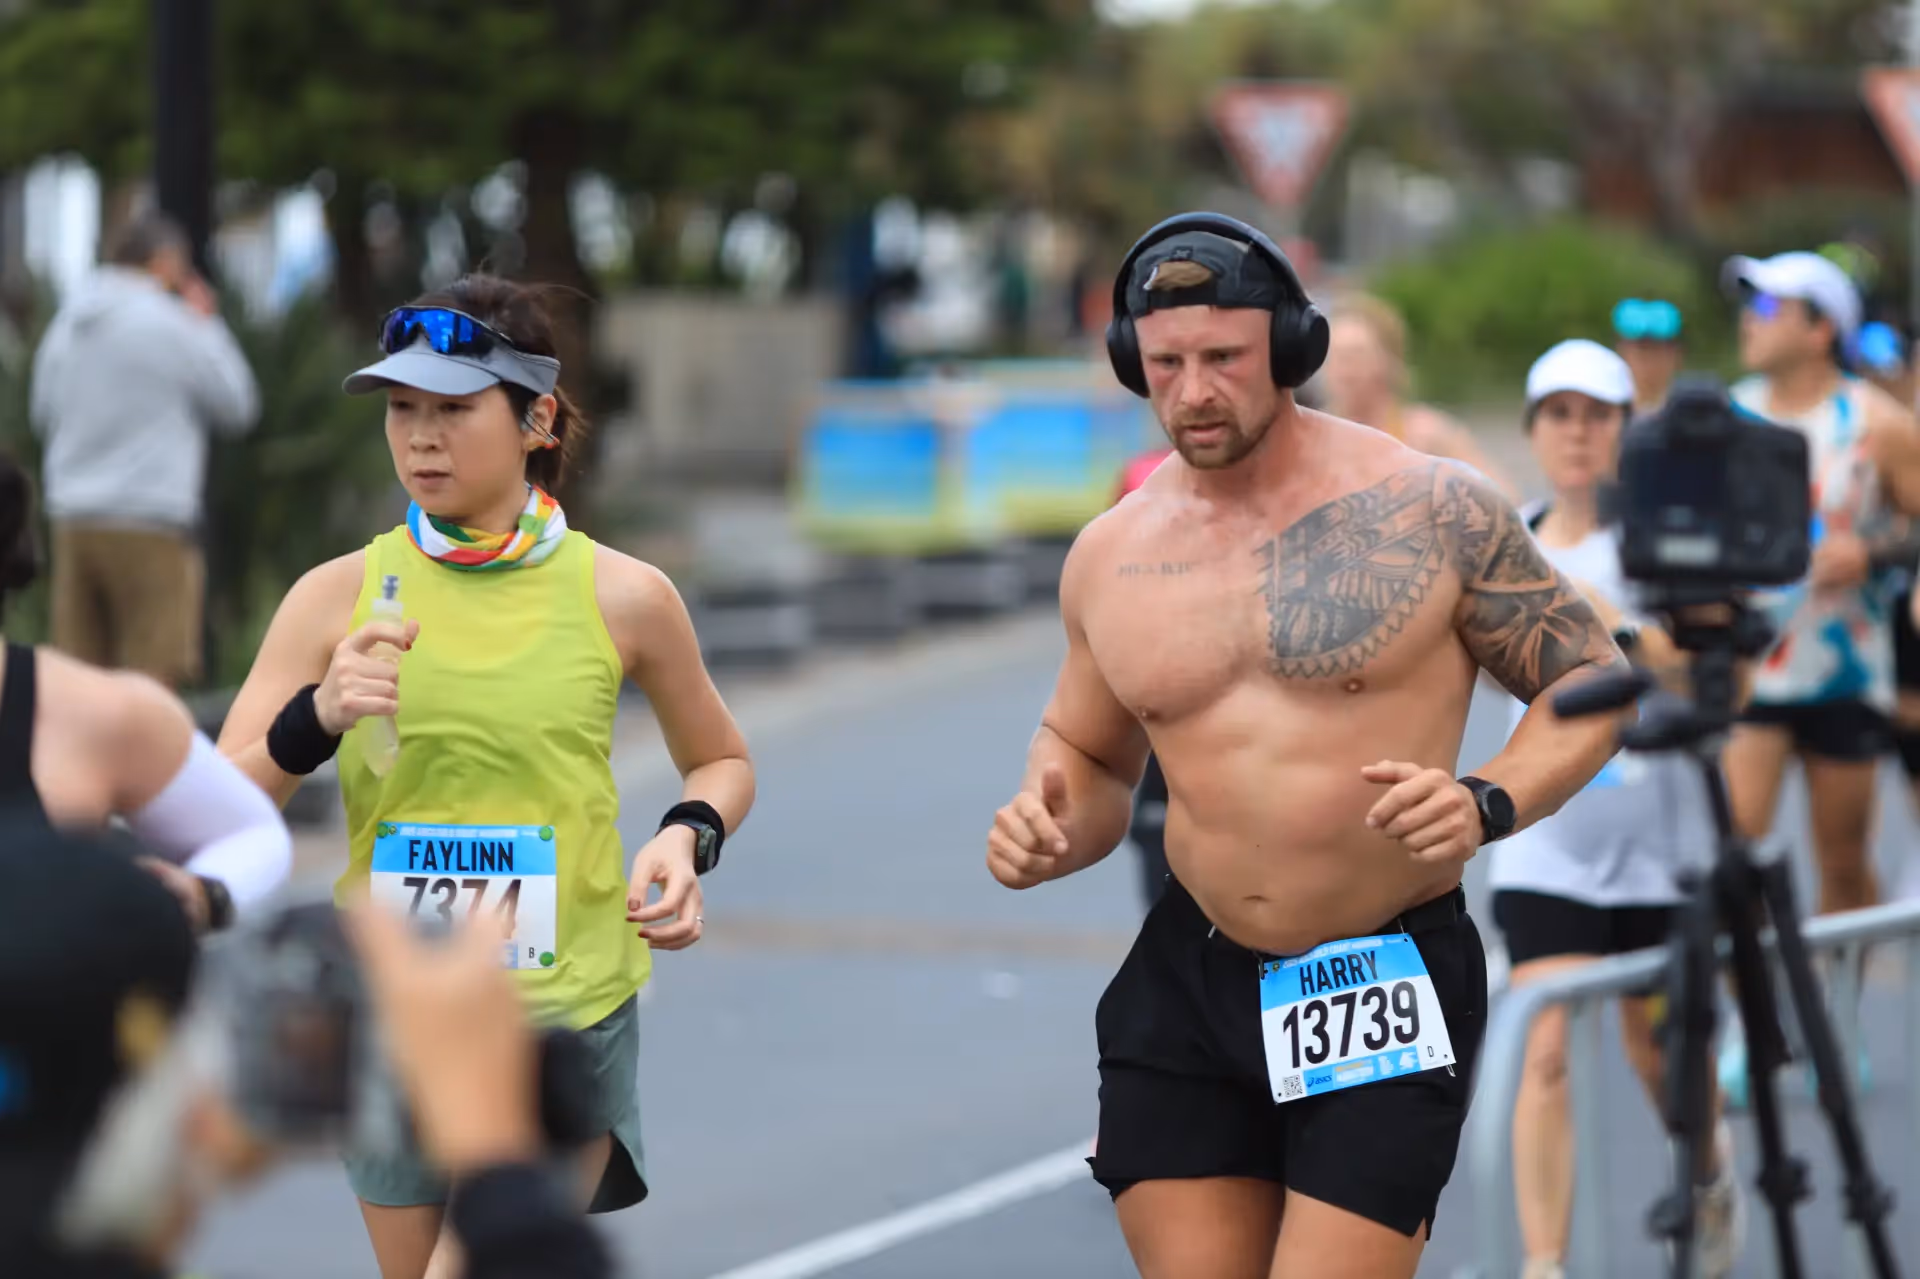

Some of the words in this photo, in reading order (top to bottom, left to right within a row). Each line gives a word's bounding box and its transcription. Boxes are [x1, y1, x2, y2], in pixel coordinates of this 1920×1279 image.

[408, 839, 514, 872] FAYLINN
[528, 947, 535, 959] B
[1299, 950, 1379, 996] HARRY
[1282, 980, 1421, 1069] 13739
